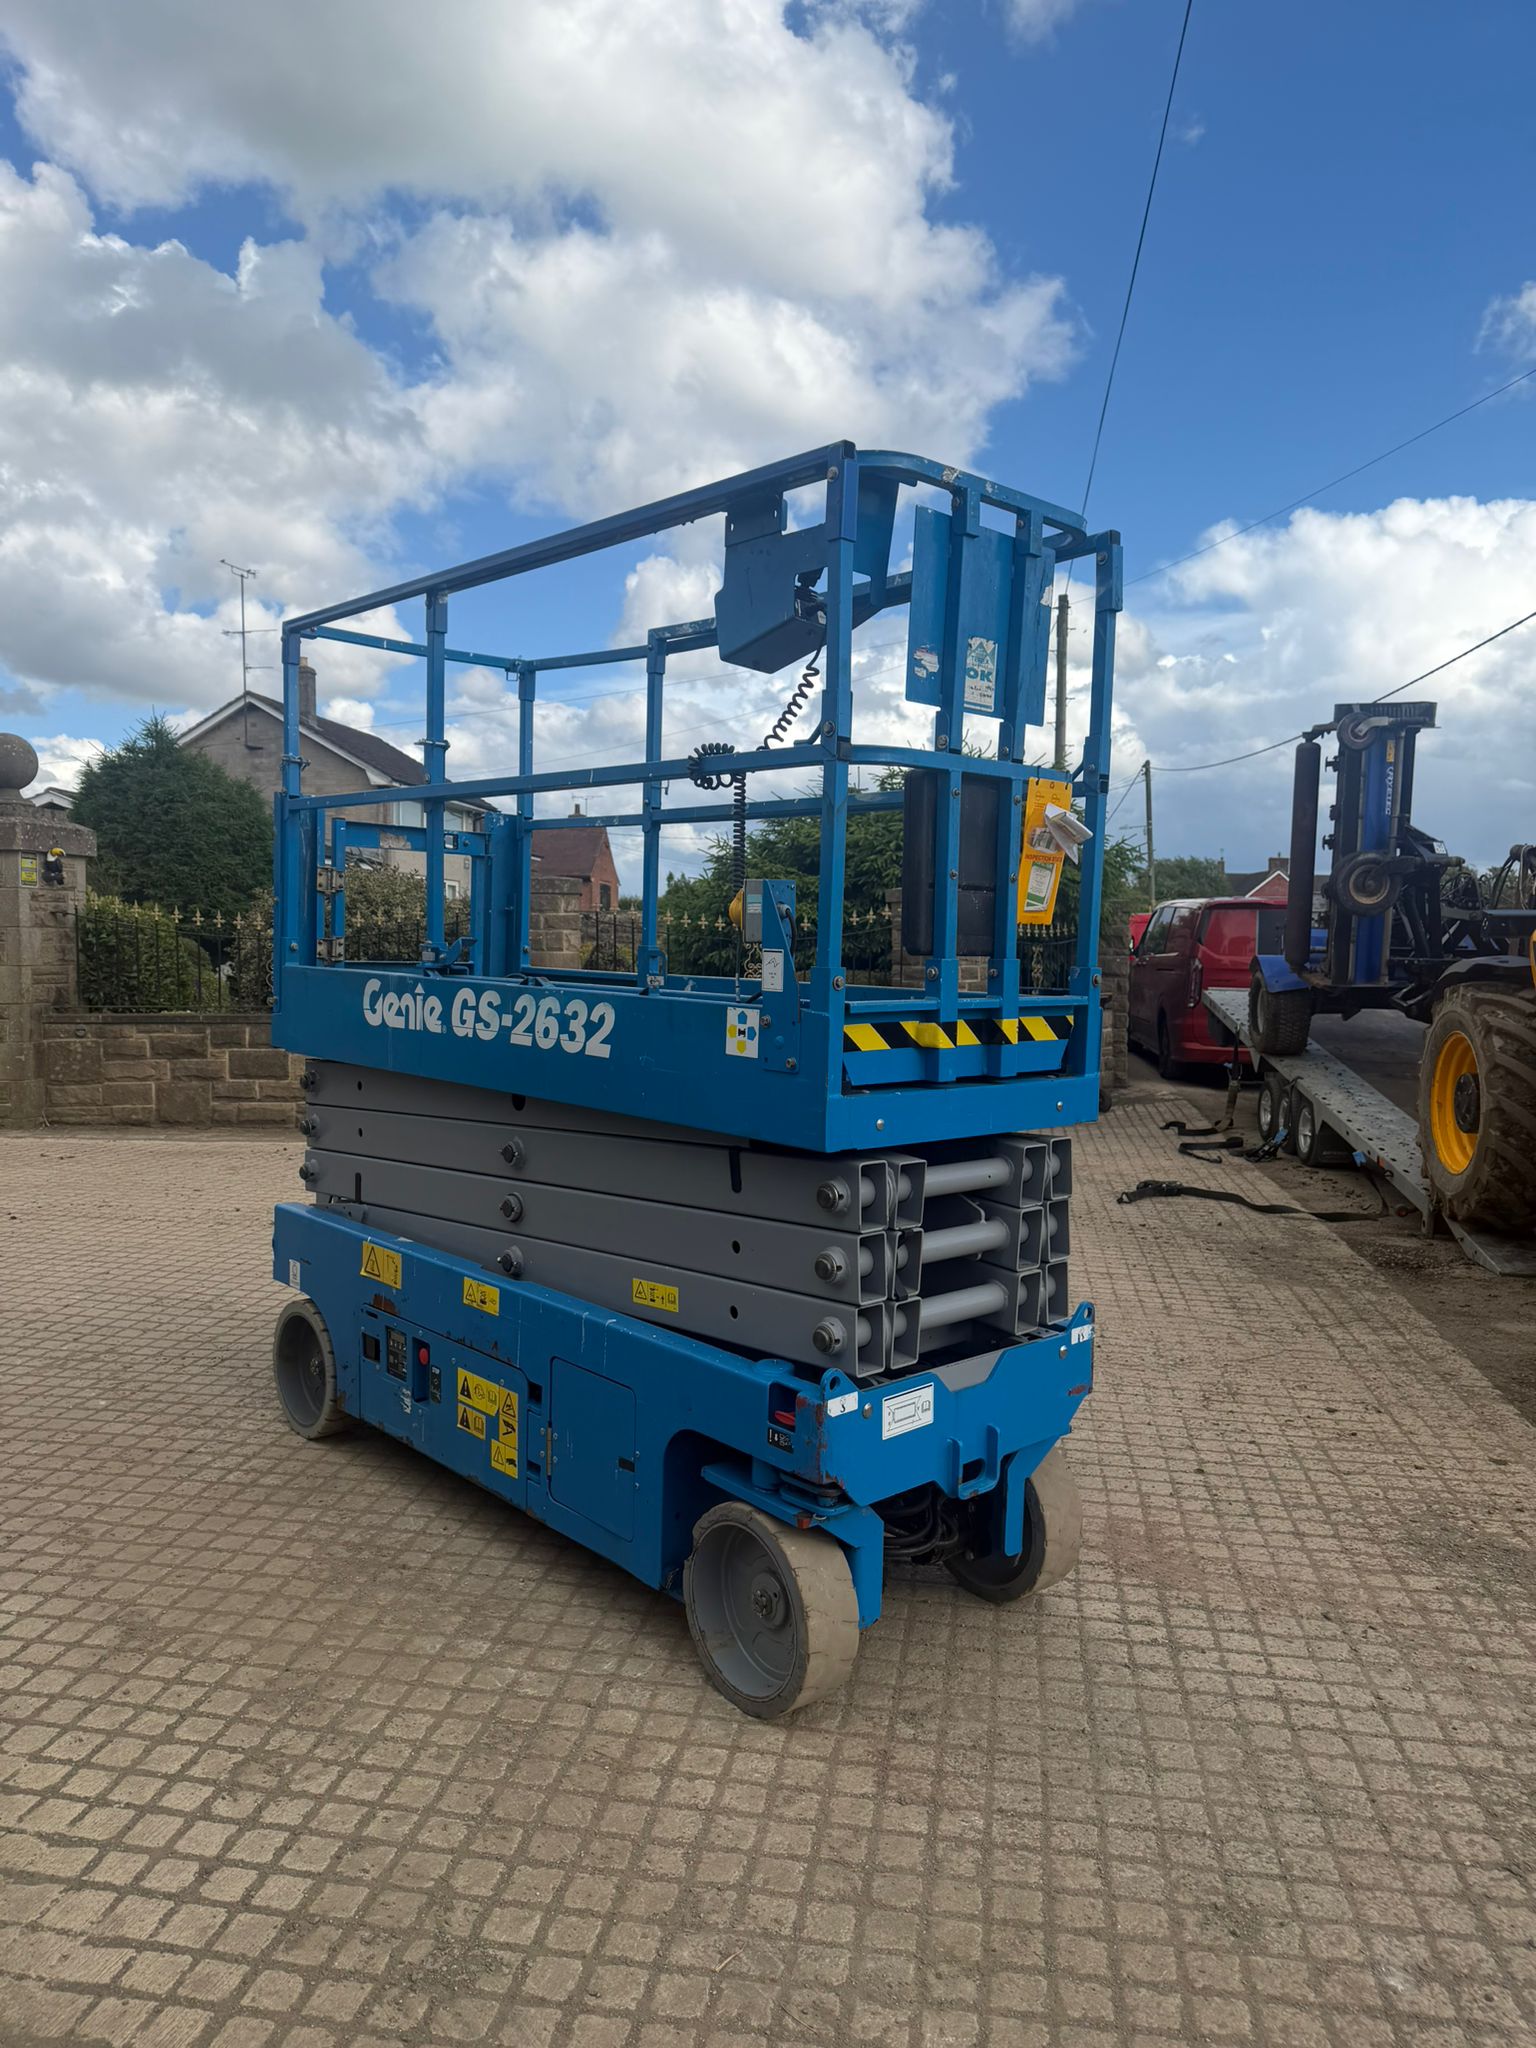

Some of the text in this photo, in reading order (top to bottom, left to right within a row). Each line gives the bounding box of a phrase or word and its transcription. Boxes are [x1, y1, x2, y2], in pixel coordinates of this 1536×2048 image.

[966, 667, 992, 682] OK
[363, 978, 615, 1058] Genie GS-2632
